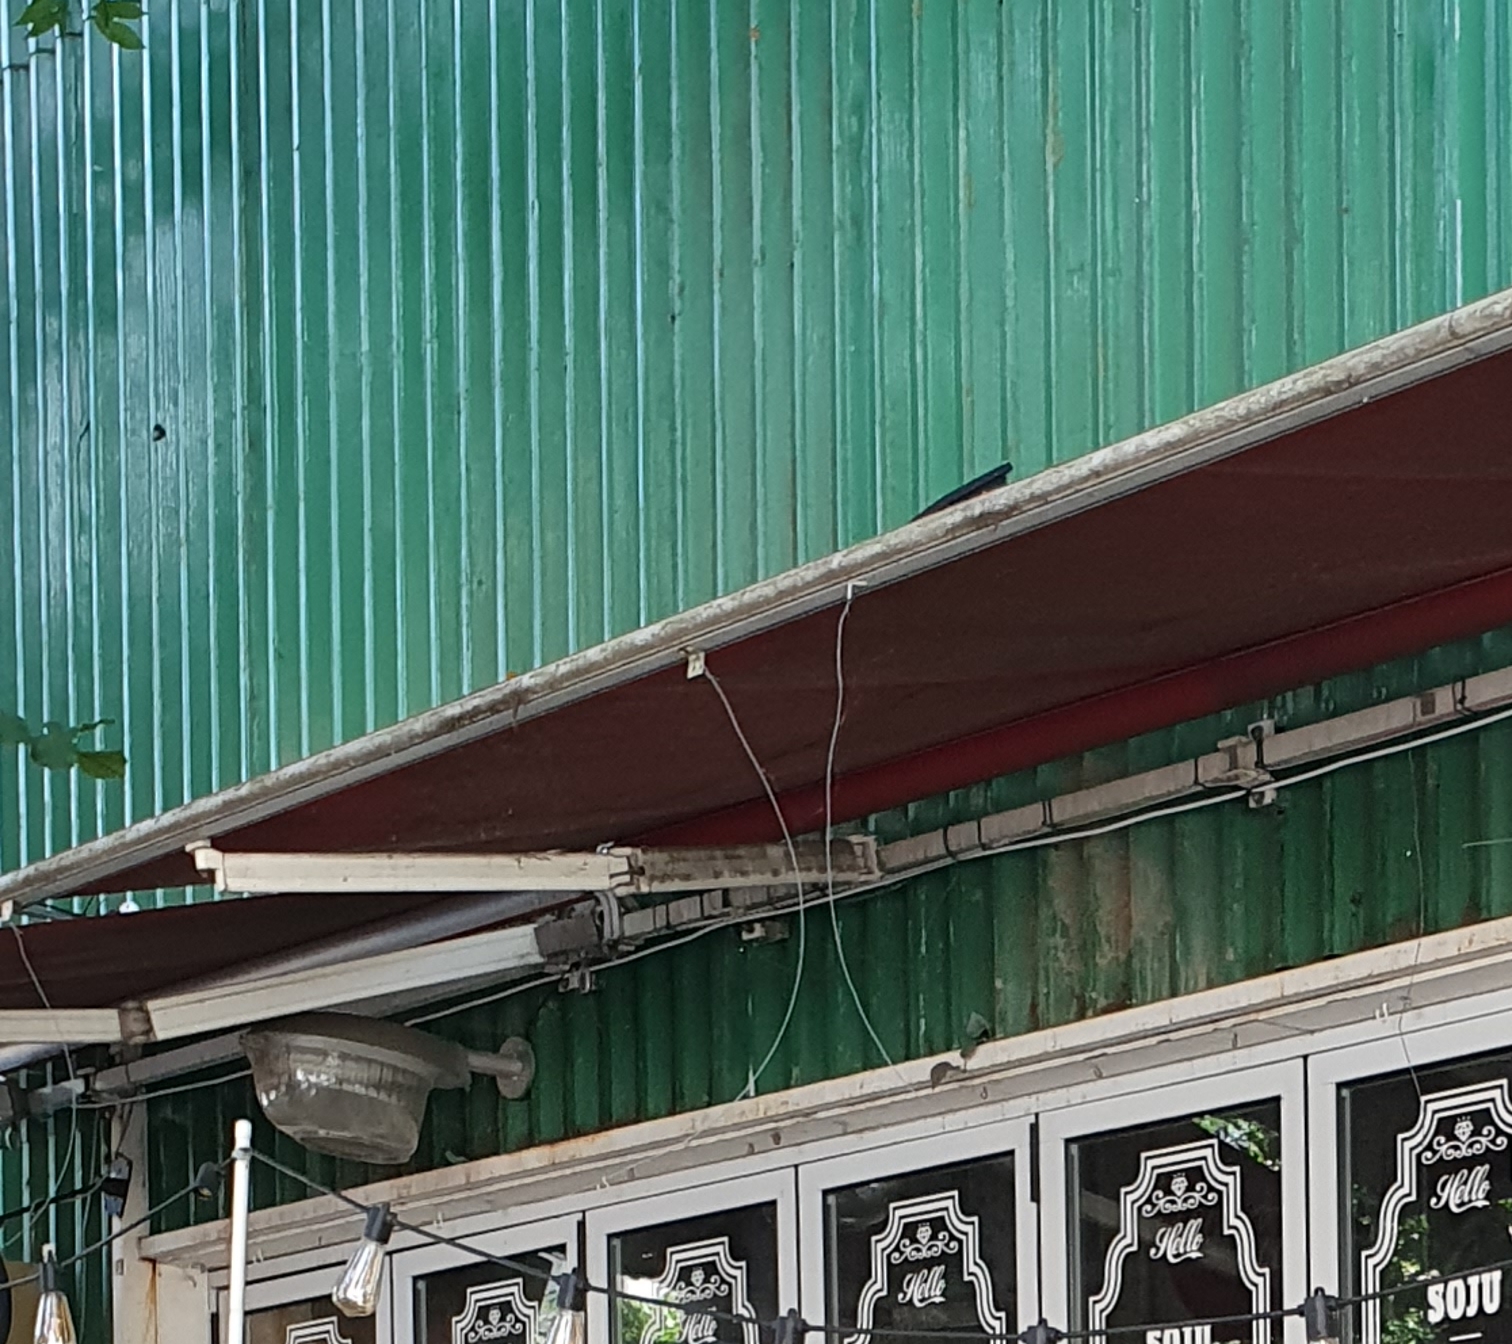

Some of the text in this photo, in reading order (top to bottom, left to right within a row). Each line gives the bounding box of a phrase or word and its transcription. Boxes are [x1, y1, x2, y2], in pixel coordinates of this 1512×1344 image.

[1430, 1164, 1492, 1213] Hello
[1149, 1218, 1205, 1264] Hello
[898, 1265, 946, 1308] Hello
[1426, 1270, 1502, 1326] SOJU
